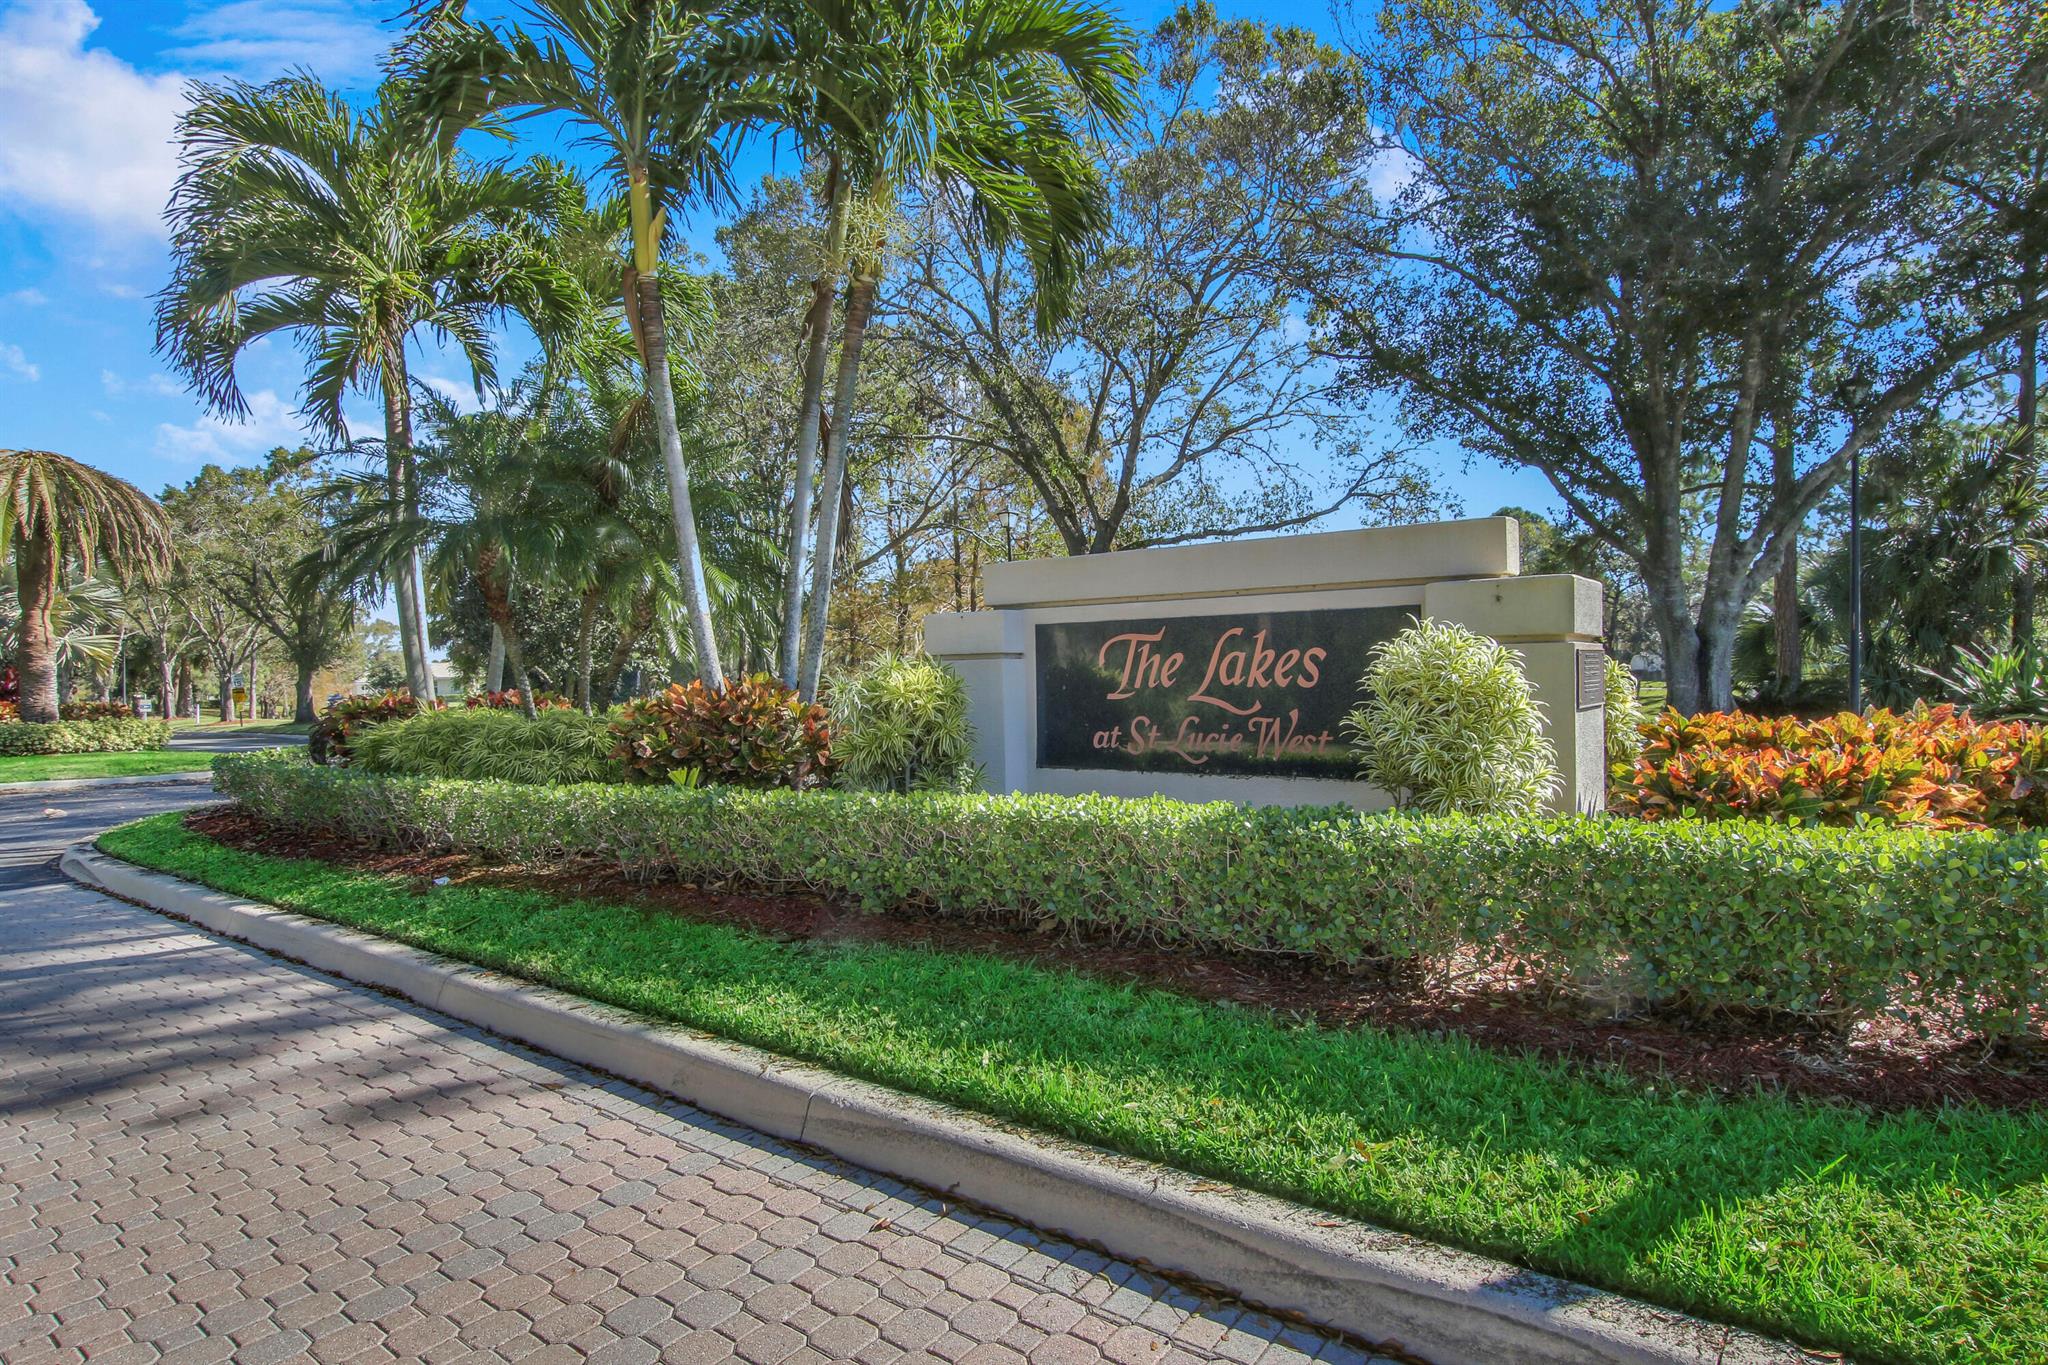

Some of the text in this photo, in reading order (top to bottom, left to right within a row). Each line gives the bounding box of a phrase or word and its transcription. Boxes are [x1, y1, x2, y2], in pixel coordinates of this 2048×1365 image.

[1098, 625, 1328, 717] The Lakes
[1092, 725, 1122, 749] at
[1168, 715, 1244, 765] Lucie
[1247, 708, 1334, 761] West
